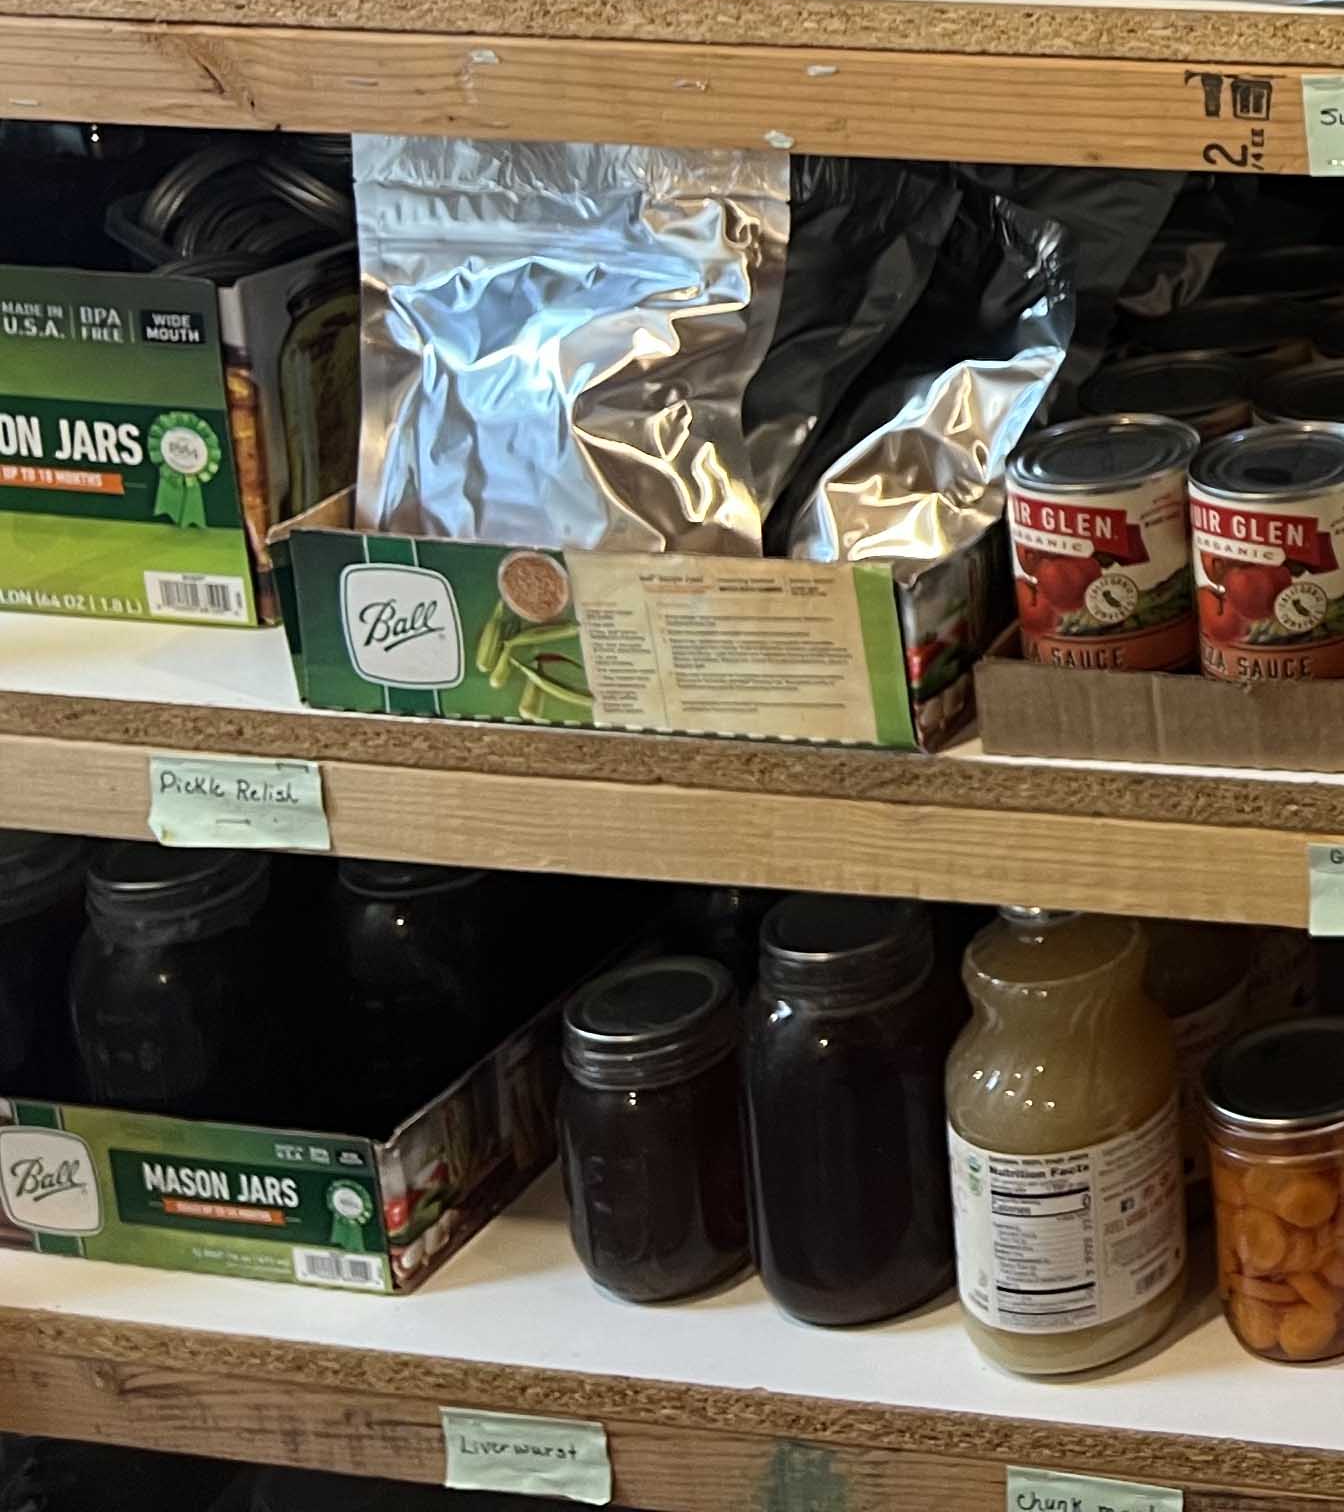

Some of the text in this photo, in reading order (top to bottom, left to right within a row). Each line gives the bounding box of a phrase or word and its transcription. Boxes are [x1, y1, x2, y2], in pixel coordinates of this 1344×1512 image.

[3, 317, 65, 339] U.S.A.
[145, 325, 200, 343] MOUTH
[151, 311, 191, 328] WIDE
[54, 417, 144, 466] JARS
[1040, 506, 1113, 540] GLEN
[1231, 514, 1304, 547] GLEN
[358, 597, 446, 653] Ball
[1238, 655, 1314, 681] SAUCE
[159, 770, 299, 804] Pickle Relish
[10, 1156, 90, 1202] Ball
[141, 1161, 300, 1208] MASON JARS
